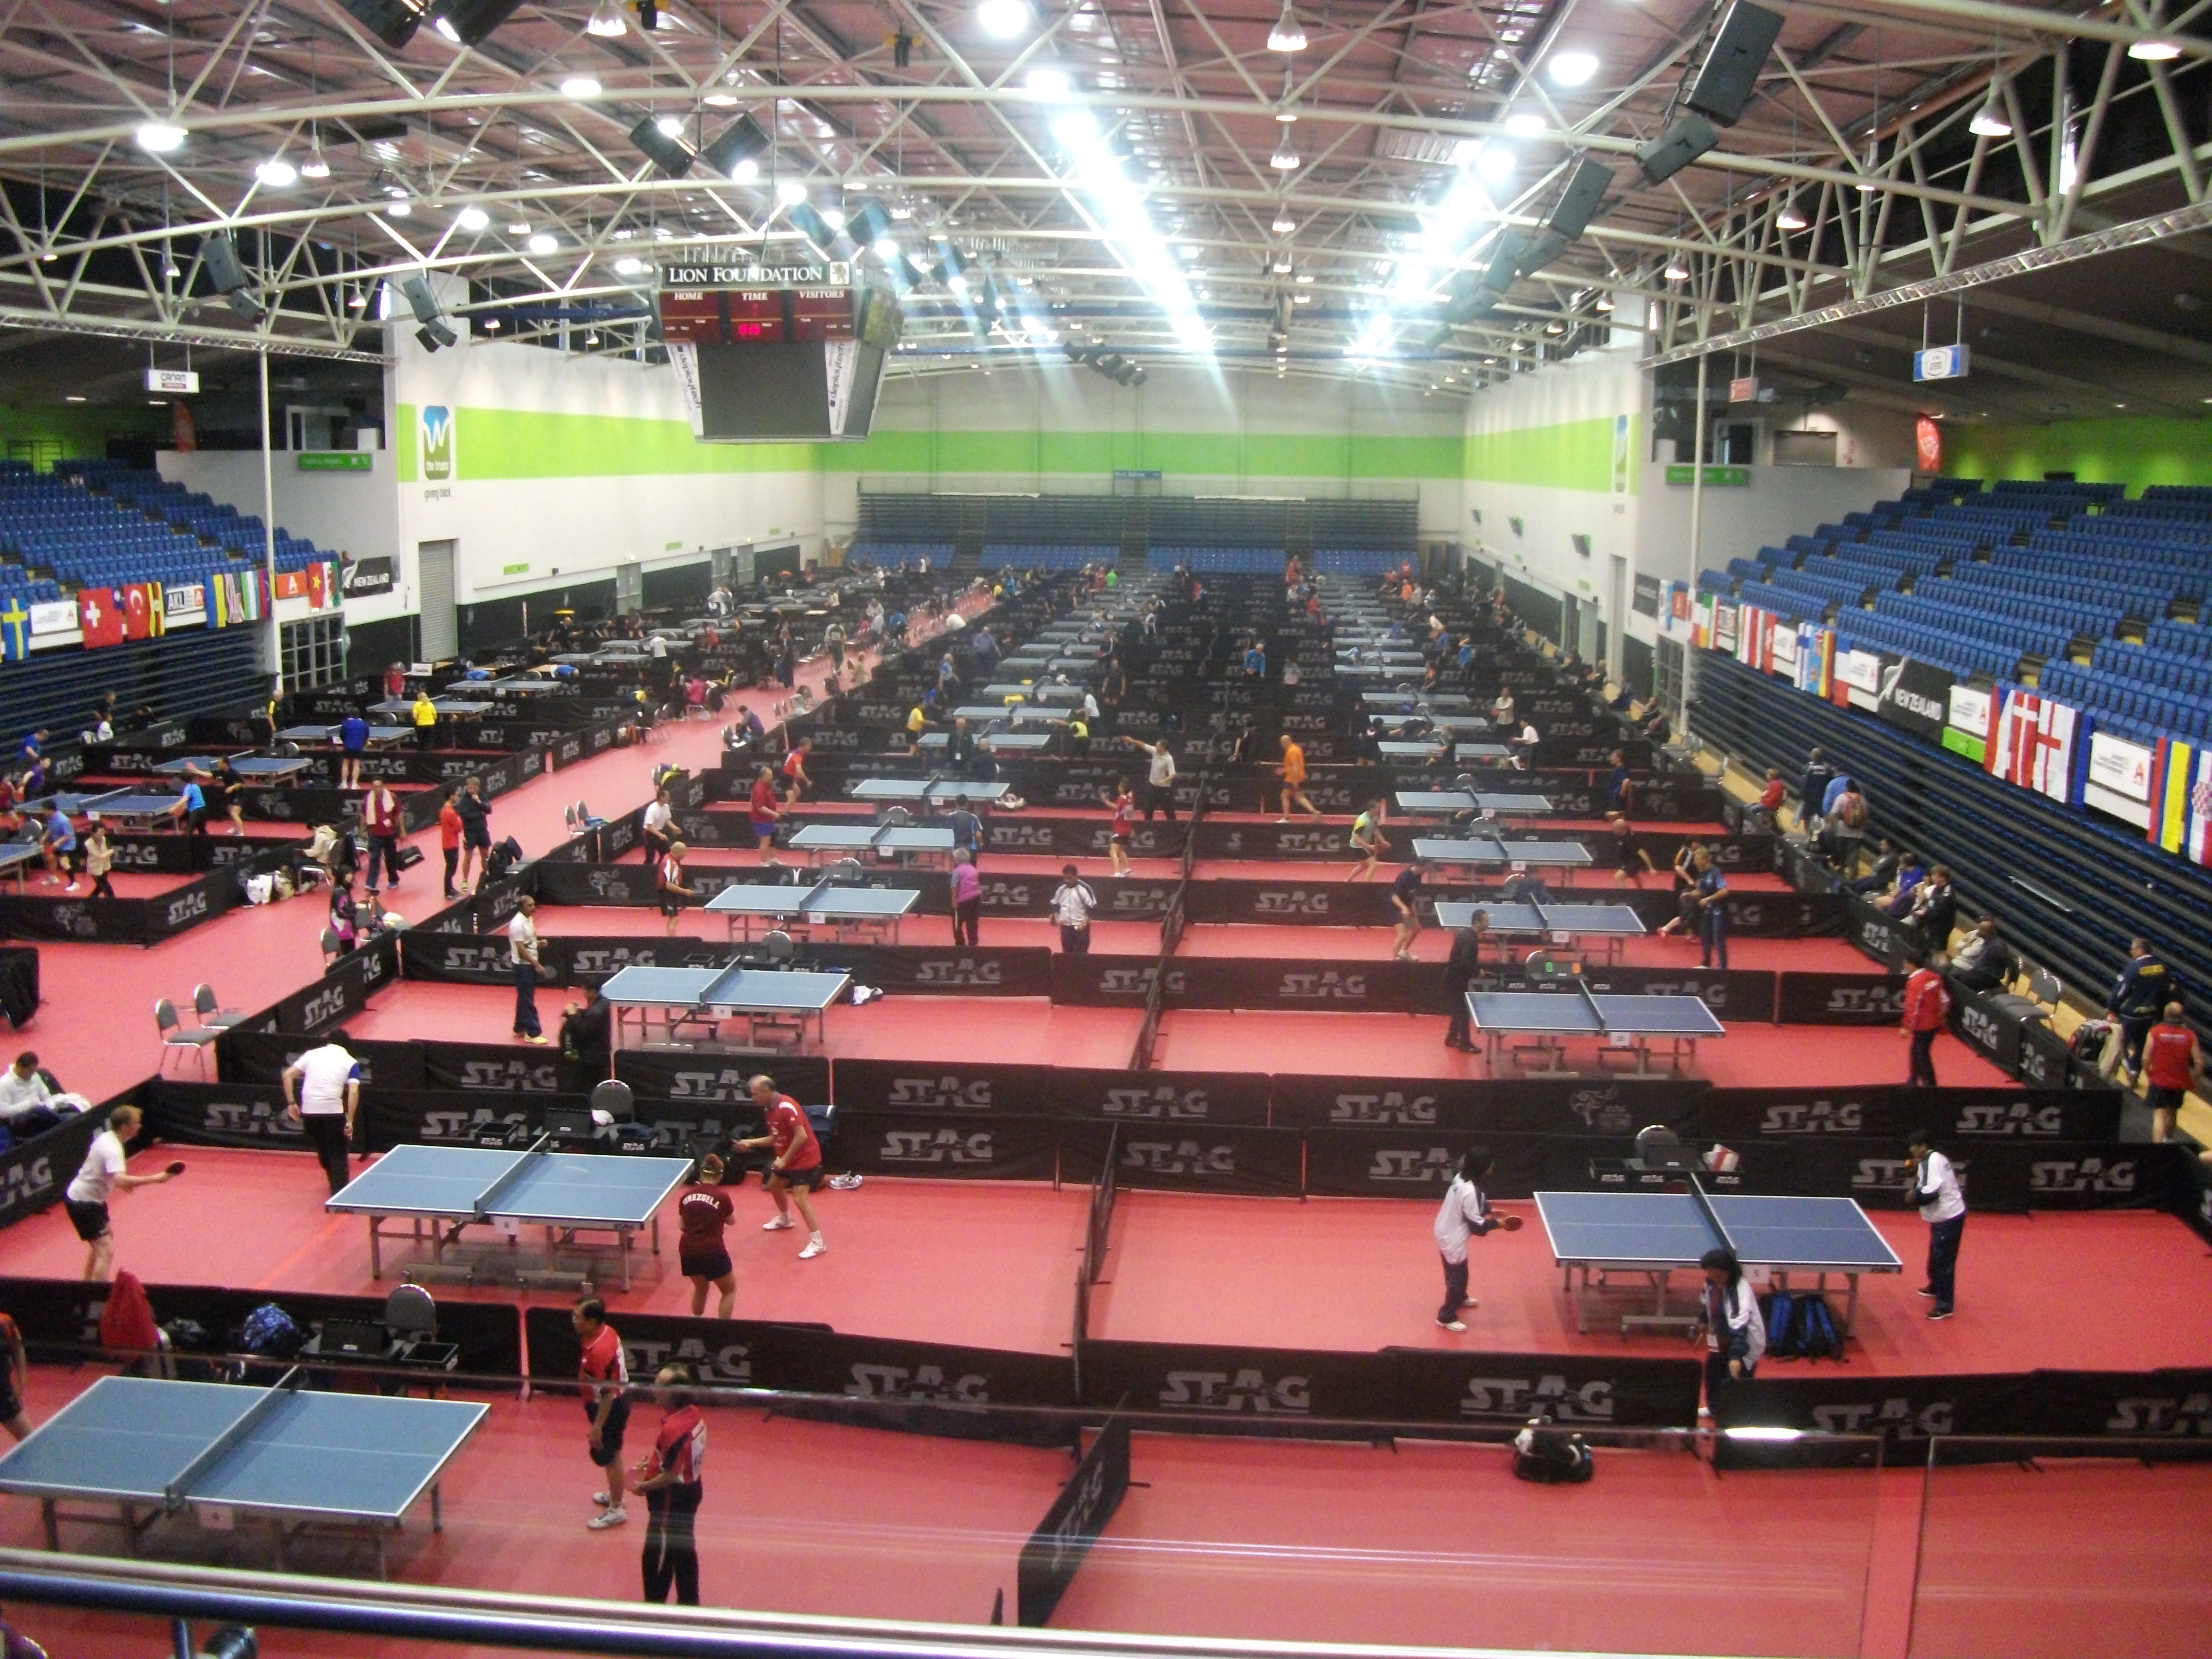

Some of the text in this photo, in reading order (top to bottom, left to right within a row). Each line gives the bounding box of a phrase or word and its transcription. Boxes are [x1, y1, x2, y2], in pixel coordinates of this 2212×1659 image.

[669, 267, 823, 283] LION FOUNDATION
[674, 292, 703, 300] HOME
[742, 293, 768, 301] TIME
[799, 290, 844, 299] VISITORS
[353, 573, 389, 587] NEW ZEALAND
[1895, 687, 1910, 708] NEW
[1909, 692, 1942, 721] ZEALAND
[1577, 747, 1610, 761] STA
[1300, 788, 1350, 805] TAG
[1548, 794, 1590, 811] TAG
[1093, 828, 1155, 849] STG
[1277, 832, 1339, 851] STAG
[111, 844, 158, 864] TAG
[213, 844, 270, 865] STA
[980, 883, 1029, 905] TAG
[1114, 889, 1178, 911] STAG
[1255, 891, 1327, 914] STAG
[573, 947, 656, 973] STAG
[916, 958, 1000, 984] STAG
[1100, 968, 1186, 994] STAG
[1280, 971, 1365, 997] STAG
[461, 1061, 557, 1091] STAG
[670, 1069, 753, 1100] STA
[889, 1077, 992, 1107] STAG
[1103, 1087, 1208, 1117] STAG
[1331, 1092, 1436, 1123] STAG
[1761, 1102, 1861, 1133] STAG
[1956, 1103, 2061, 1134] STAG
[421, 1108, 528, 1140] STAG
[881, 1129, 993, 1161] STAG
[1122, 1140, 1234, 1173] STAG
[0, 1157, 53, 1196] TAG
[1369, 1148, 1465, 1181] STA
[2030, 1158, 2135, 1191] STAG
[844, 1363, 989, 1413] STAG
[1159, 1369, 1310, 1414] STAG
[1460, 1375, 1613, 1421] STAG
[2107, 1392, 2212, 1436] STA
